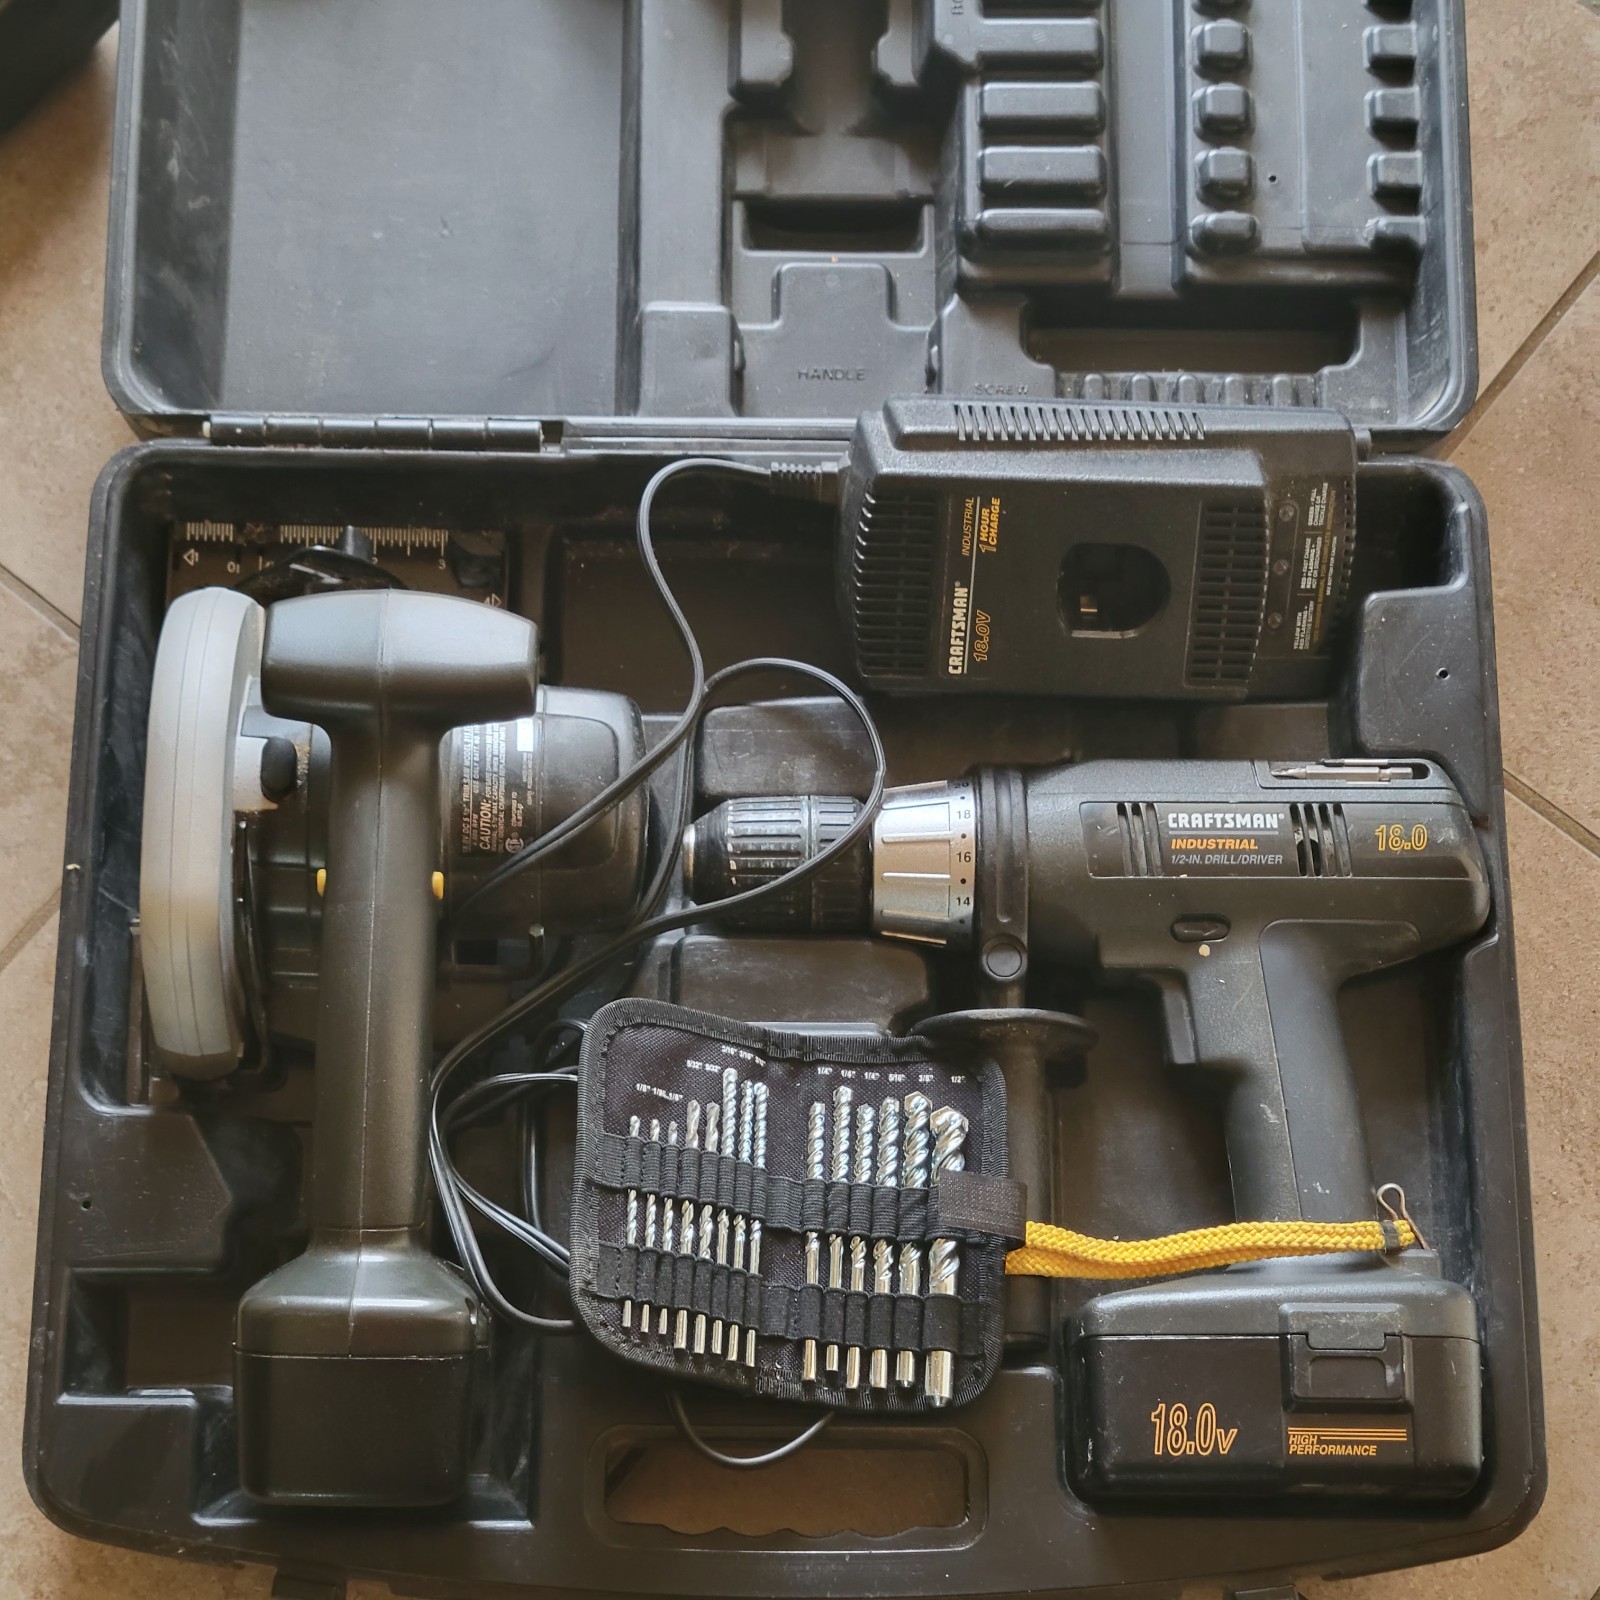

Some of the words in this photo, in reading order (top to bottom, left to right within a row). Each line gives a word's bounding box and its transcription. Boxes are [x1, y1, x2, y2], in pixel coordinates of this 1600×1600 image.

[797, 368, 866, 381] HANDLE
[961, 497, 974, 556] INDUSTRIAL
[980, 508, 990, 542] HOUR
[988, 497, 1001, 545] CHARGE
[439, 559, 447, 570] 3
[973, 610, 991, 661] 18.0V
[462, 784, 470, 801] TRIM
[957, 809, 971, 820] 18
[479, 799, 492, 850] CAUTION:
[1375, 823, 1428, 851] 18.0
[1171, 838, 1259, 850] INDUSTRIAL
[957, 851, 971, 863] 16
[1171, 854, 1203, 865] 1/2-IN.
[1205, 854, 1283, 865] DRILL/DRIVER
[956, 896, 971, 906] 14
[1151, 1403, 1238, 1456] 18.0v
[1289, 1435, 1317, 1445] HIGH
[1289, 1445, 1377, 1456] PERFORMANCE
